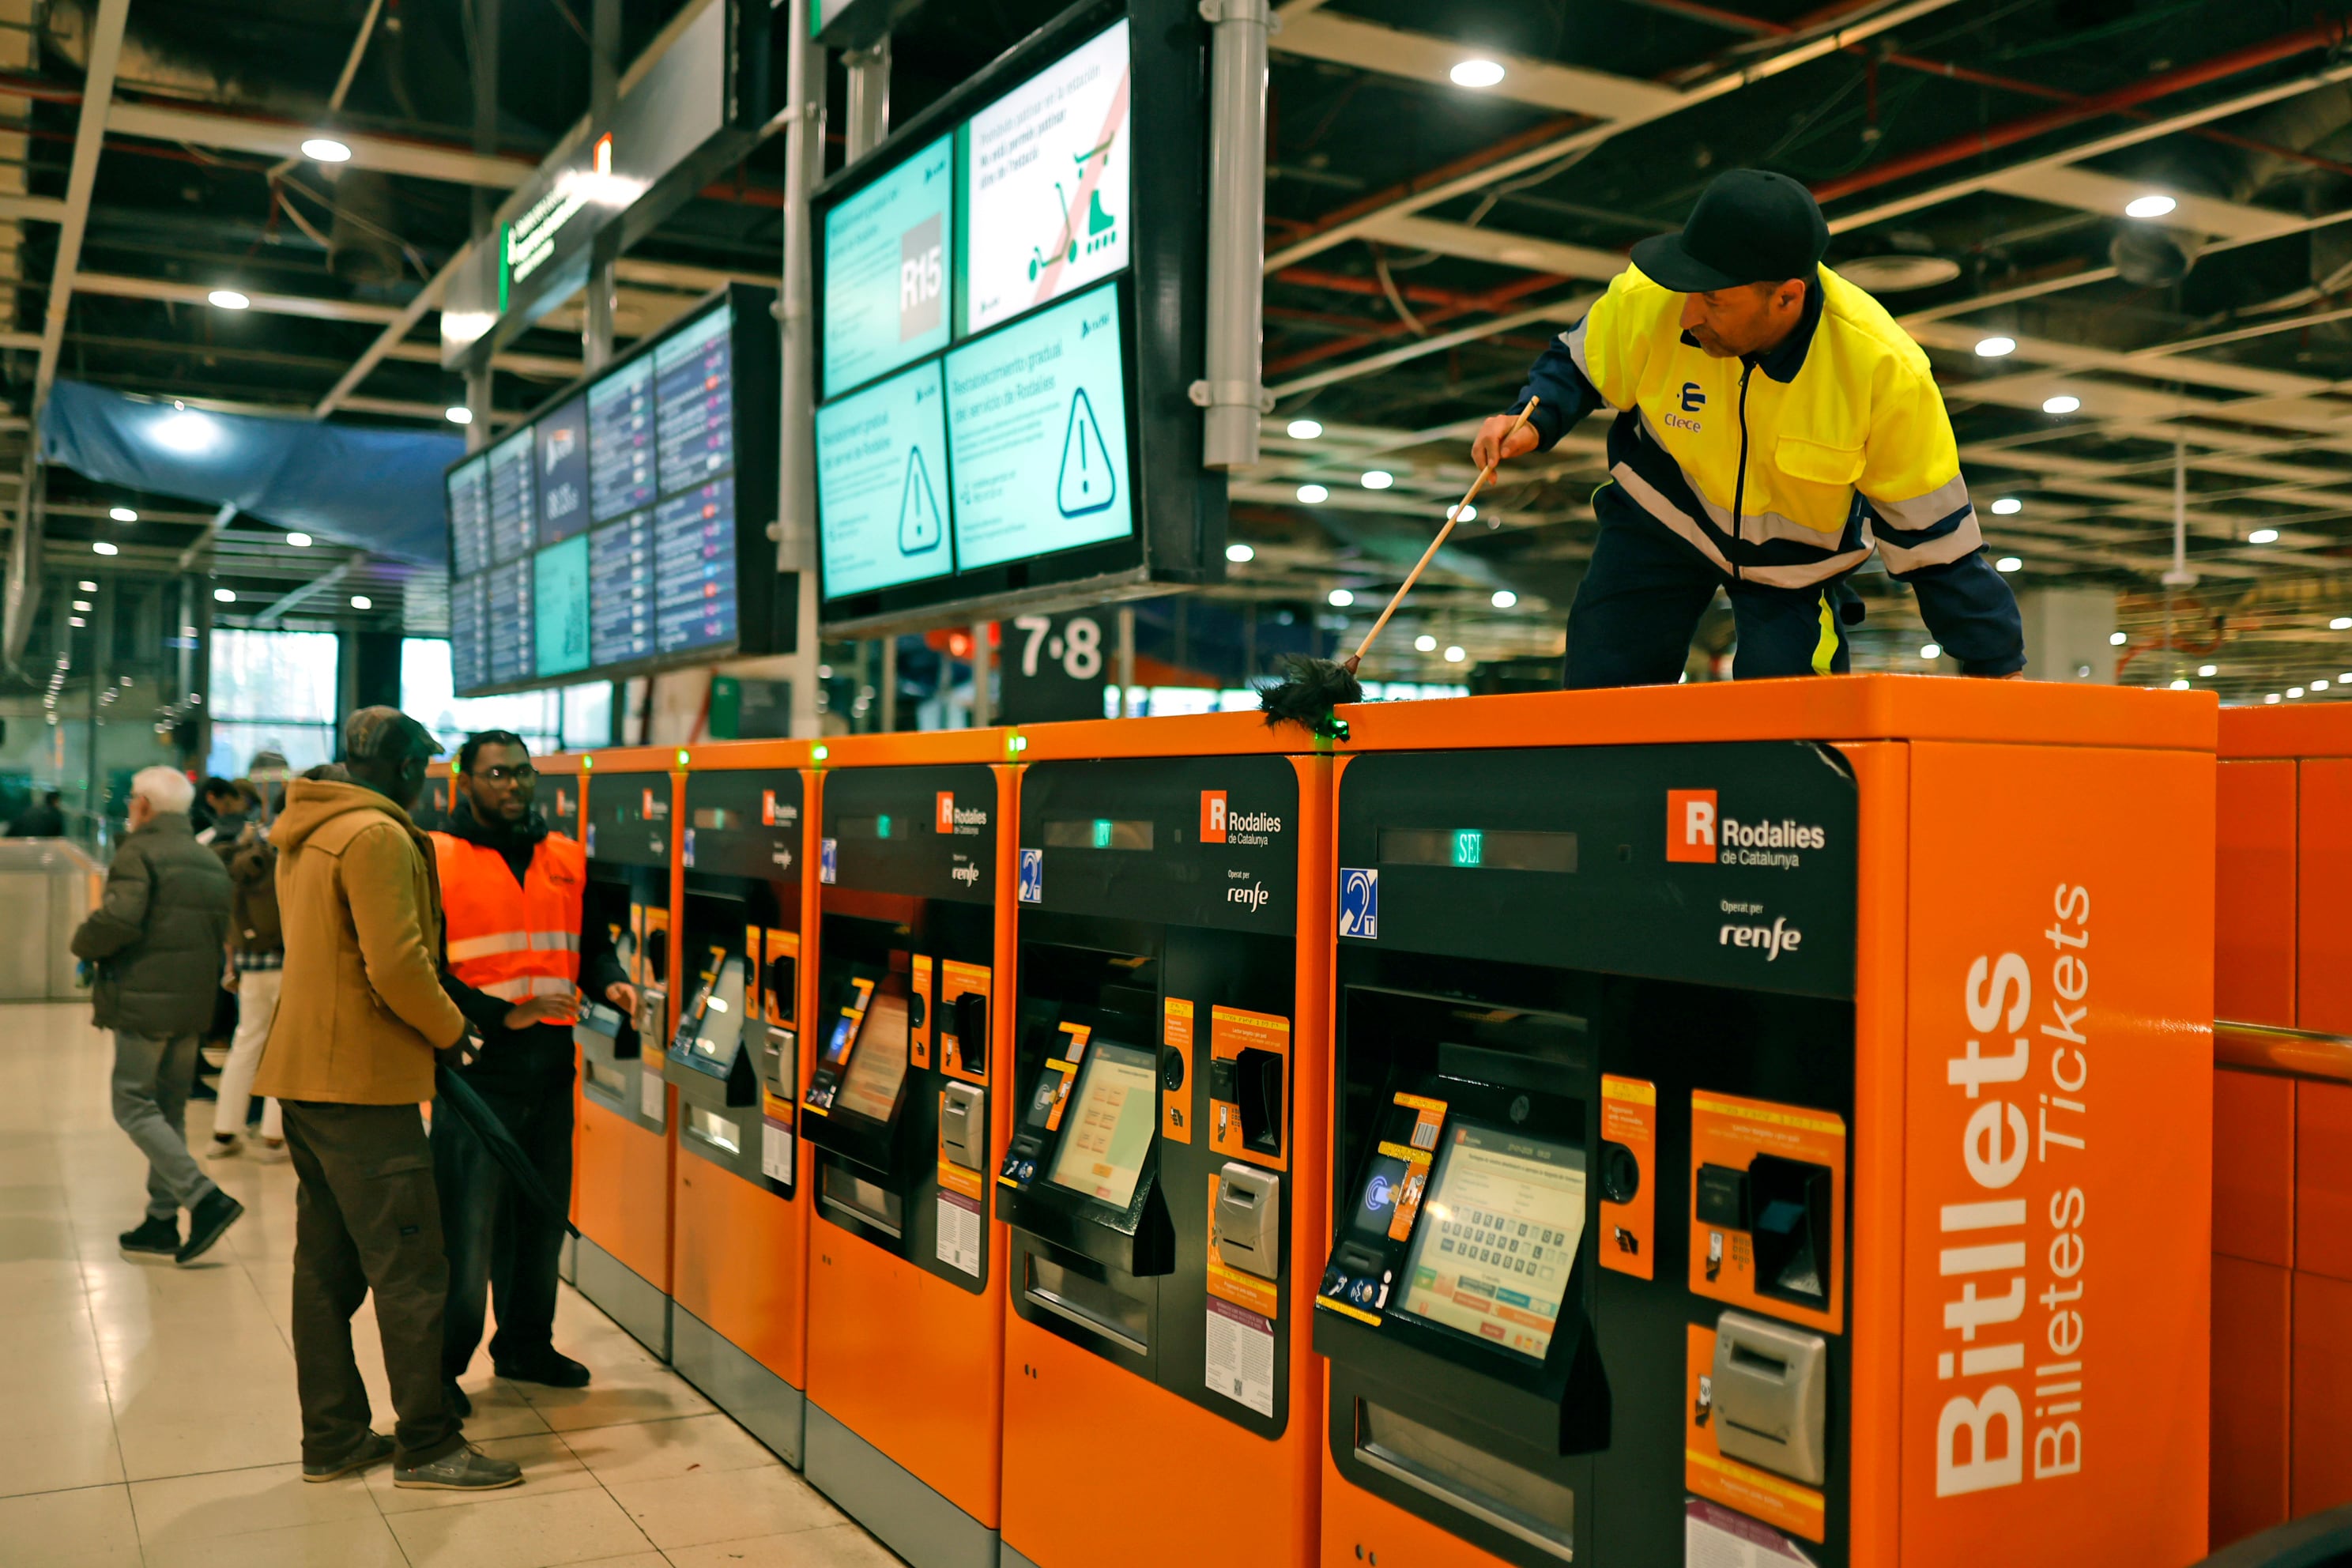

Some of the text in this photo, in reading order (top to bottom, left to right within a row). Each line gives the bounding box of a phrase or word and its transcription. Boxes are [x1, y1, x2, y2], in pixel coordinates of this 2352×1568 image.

[902, 246, 941, 312] R15
[1664, 413, 1702, 434] Clece
[954, 806, 987, 825] Rodalies
[1210, 798, 1281, 833] R Rodalies
[1686, 801, 1826, 850] R Rodalies
[1228, 832, 1268, 848] de Catalunya
[952, 861, 979, 888] renfe
[1227, 869, 1242, 880] Operat
[1721, 849, 1800, 871] de Catalunya
[1227, 880, 1269, 913] renfe
[1720, 899, 1764, 916] Operat per
[1719, 916, 1803, 963] renfe
[2034, 883, 2090, 1479] Billetes Tickets
[1936, 952, 2032, 1498] Bitllets
